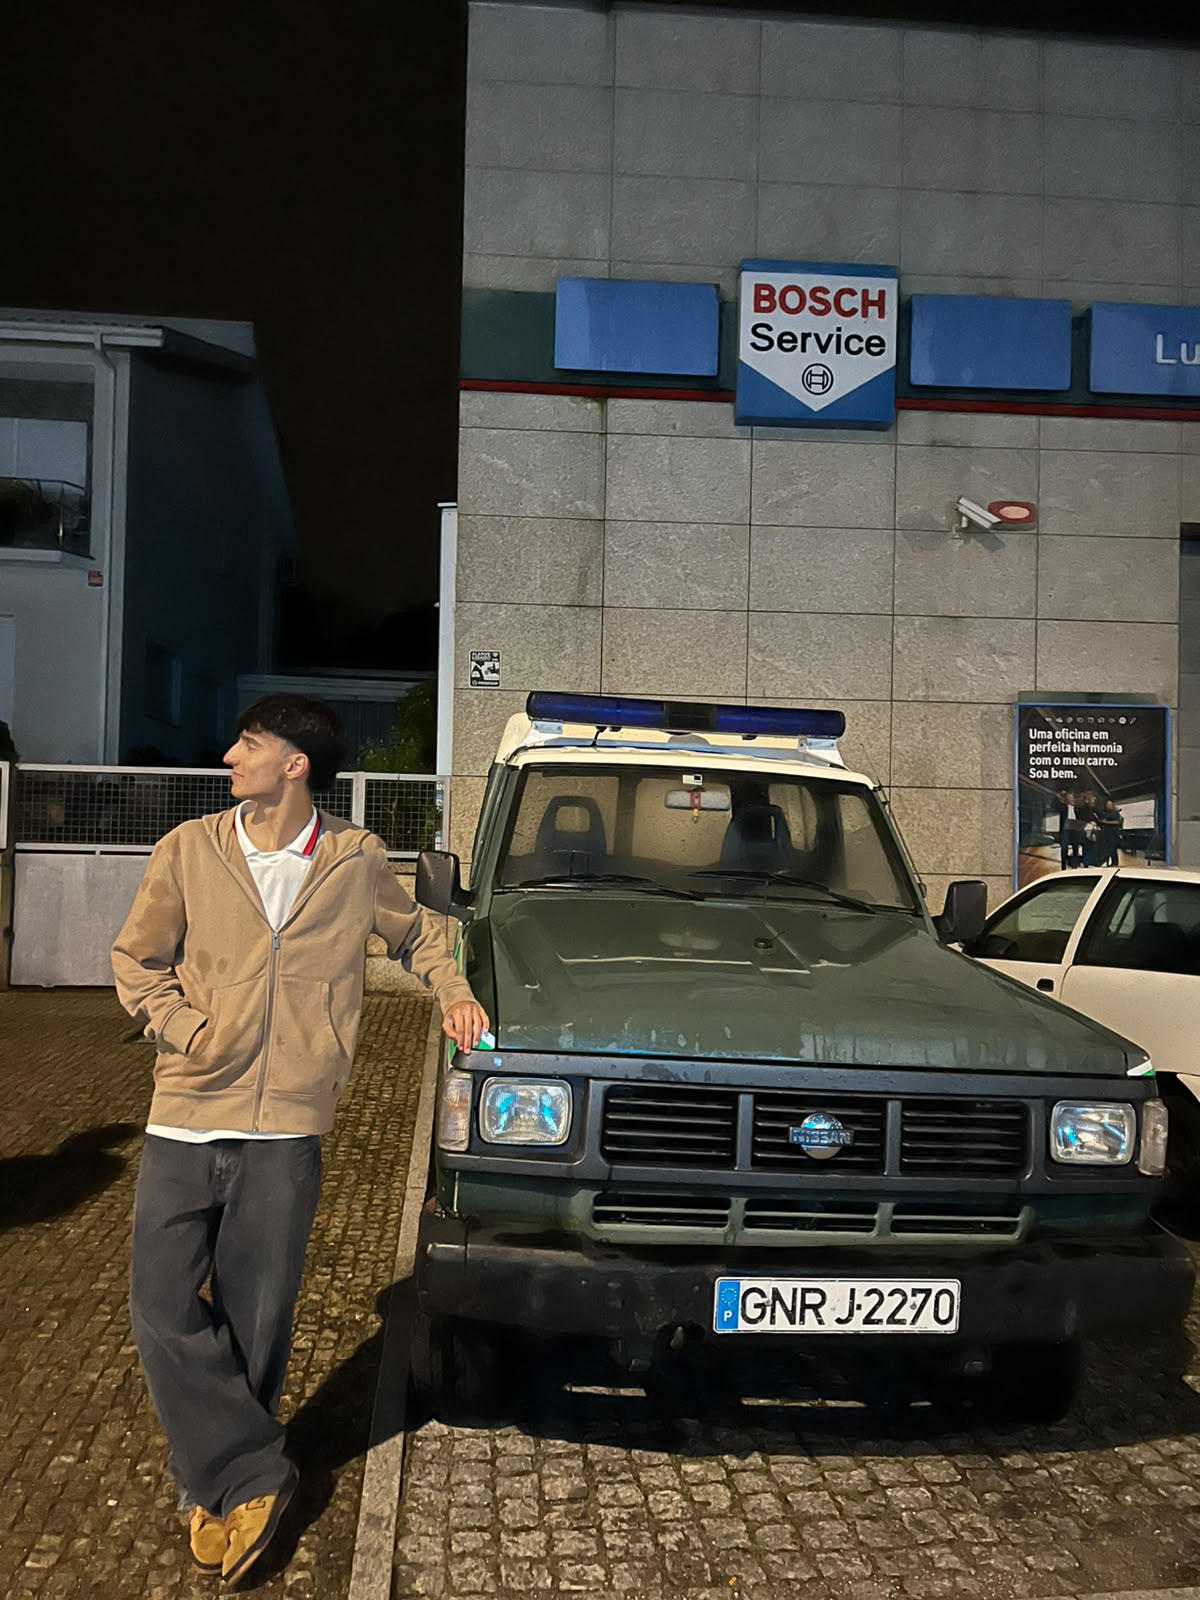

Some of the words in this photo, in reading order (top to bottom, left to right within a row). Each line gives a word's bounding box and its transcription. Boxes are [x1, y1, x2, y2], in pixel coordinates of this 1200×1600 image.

[752, 283, 886, 319] BOSCH
[749, 322, 886, 357] Service
[1029, 728, 1053, 739] Uma
[1055, 728, 1090, 740] oficina
[1092, 731, 1109, 740] em
[1029, 741, 1071, 754] perfeita
[1073, 741, 1123, 753] harmonia
[1029, 756, 1051, 765] com
[1053, 757, 1060, 765] o
[1062, 757, 1085, 765] meu
[1086, 757, 1118, 766] carro.
[1029, 767, 1049, 778] Soa
[1051, 767, 1077, 779] bem.
[793, 1129, 851, 1145] NISSAN
[740, 1287, 827, 1326] GNR
[723, 1310, 732, 1321] P
